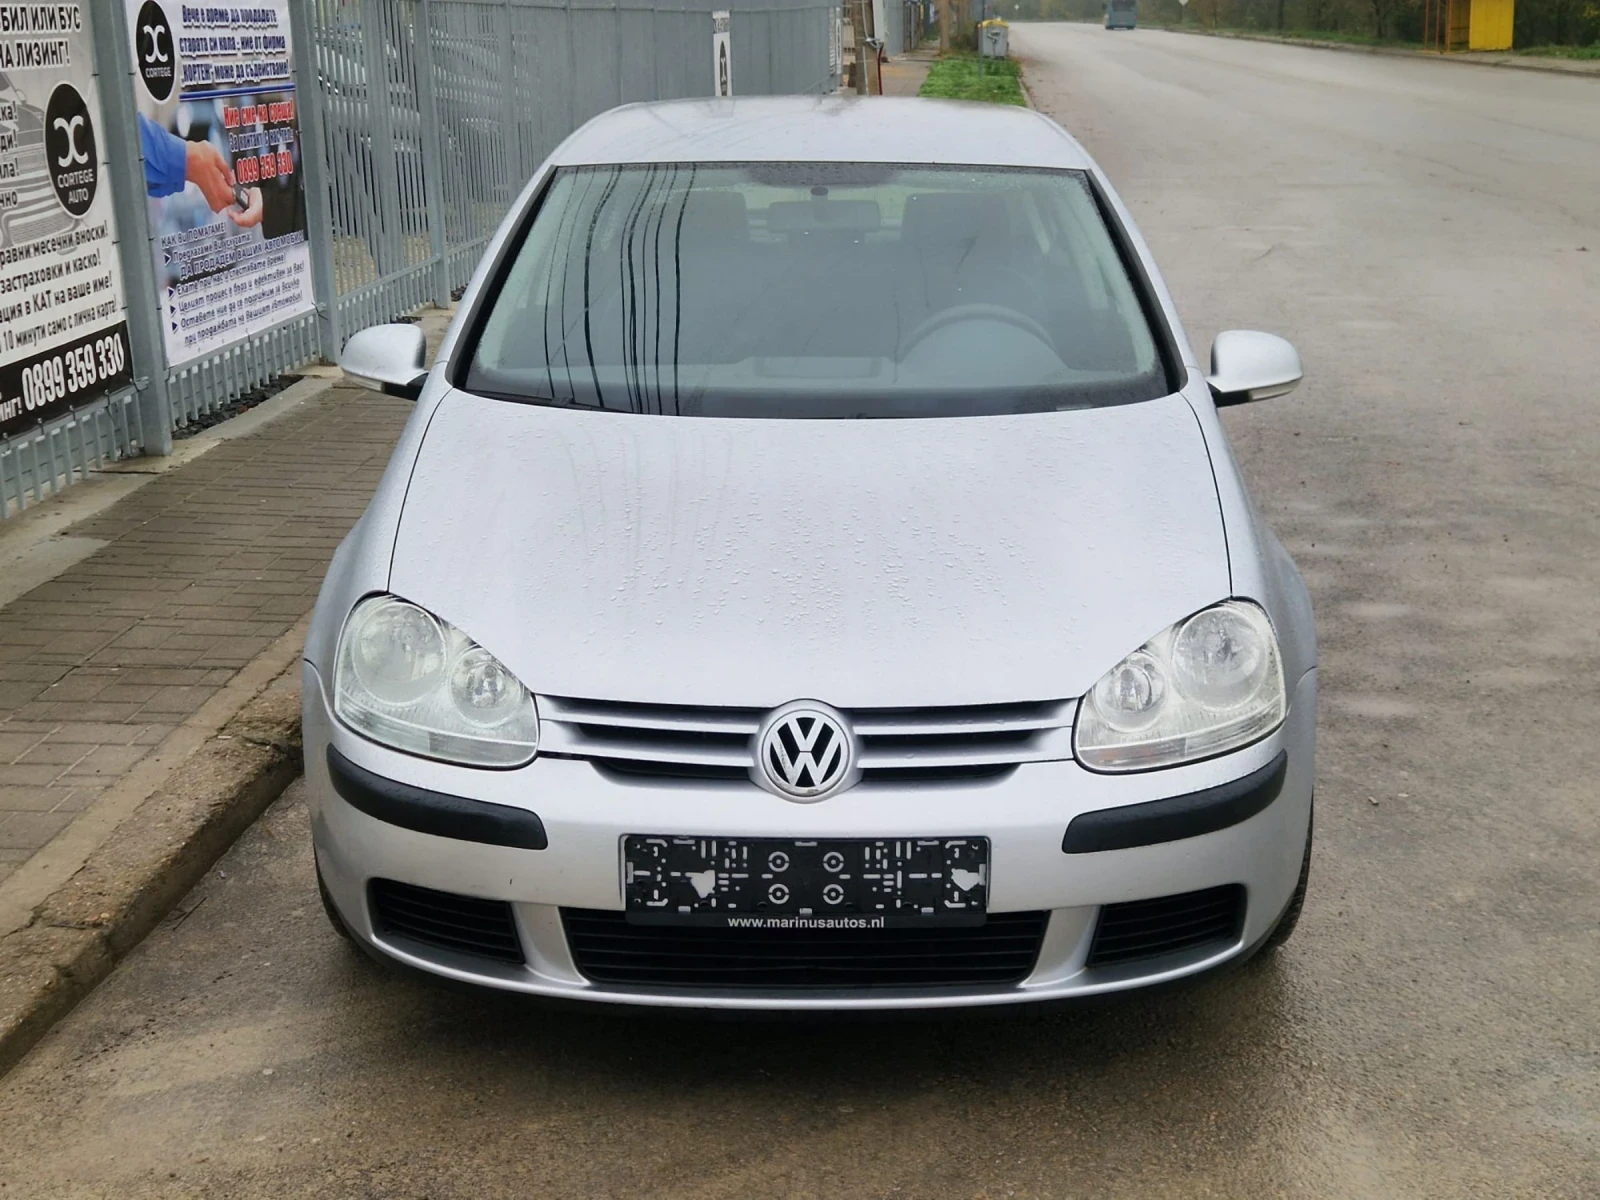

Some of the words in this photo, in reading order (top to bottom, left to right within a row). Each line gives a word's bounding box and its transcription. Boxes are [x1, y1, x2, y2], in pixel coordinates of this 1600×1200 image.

[30, 6, 57, 31] ИЛИ
[58, 6, 81, 30] БУС
[182, 4, 200, 23] Вече
[231, 8, 240, 24] да
[16, 40, 70, 67] ЛИЗИНГ!
[179, 37, 208, 54] старата
[209, 37, 217, 52] си
[219, 36, 236, 51] кола
[240, 36, 253, 50] ние
[254, 35, 262, 49] от
[263, 34, 285, 50] фирма
[145, 66, 172, 78] CORTEGE
[235, 63, 245, 80] да
[223, 105, 239, 128] Ние
[241, 106, 256, 126] сме
[257, 104, 268, 123] на
[57, 168, 94, 188] CORTEGE
[237, 156, 259, 184] 0899
[260, 152, 276, 179] 359
[277, 149, 293, 176] 330
[68, 187, 89, 204] AUTO
[33, 233, 75, 256] месечни
[75, 219, 109, 246] вноски!
[0, 261, 65, 294] застраховки
[64, 260, 72, 276] и
[72, 247, 102, 274] каско!
[25, 300, 31, 316] в
[32, 289, 52, 313] КАТ
[54, 289, 66, 306] на
[67, 281, 92, 302] ваше
[92, 269, 113, 293] име!
[3, 330, 14, 352] 10
[15, 323, 47, 348] минути
[47, 317, 67, 337] само
[68, 315, 73, 329] с
[74, 307, 96, 327] лична
[21, 355, 66, 411] 0899
[65, 343, 97, 393] 359
[96, 332, 125, 380] 330
[728, 917, 884, 928] www.marinusautos.nl
